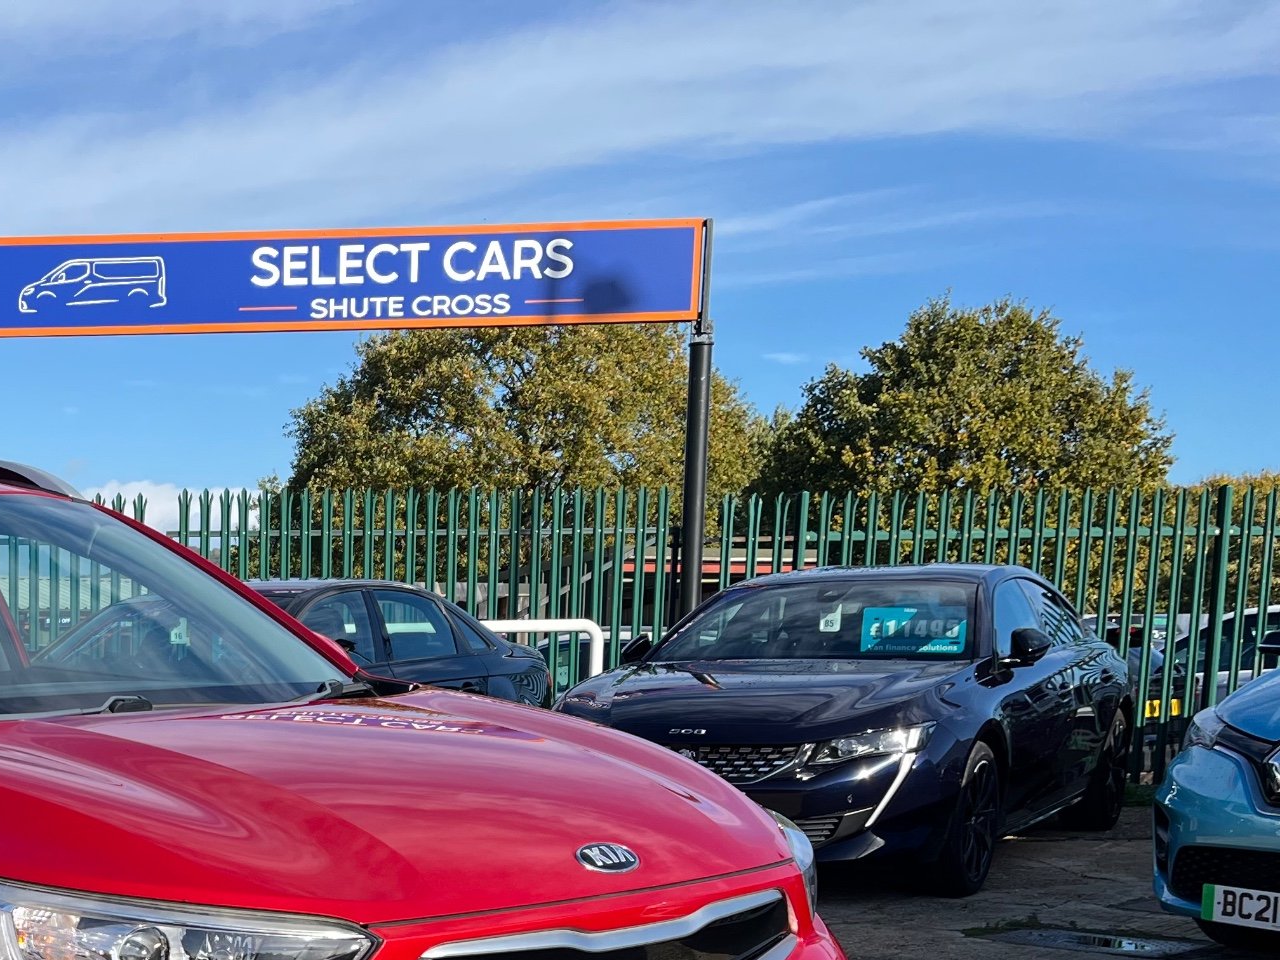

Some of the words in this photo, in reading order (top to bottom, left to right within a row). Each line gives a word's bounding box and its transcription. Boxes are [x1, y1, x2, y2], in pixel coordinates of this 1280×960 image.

[249, 241, 431, 288] SELECT
[442, 238, 575, 283] CARS
[309, 296, 405, 319] SHUTE
[411, 293, 511, 316] CROSS
[886, 644, 916, 652] finance
[919, 644, 958, 652] solutions
[582, 845, 635, 866] KIA
[1221, 889, 1279, 924] BC21
